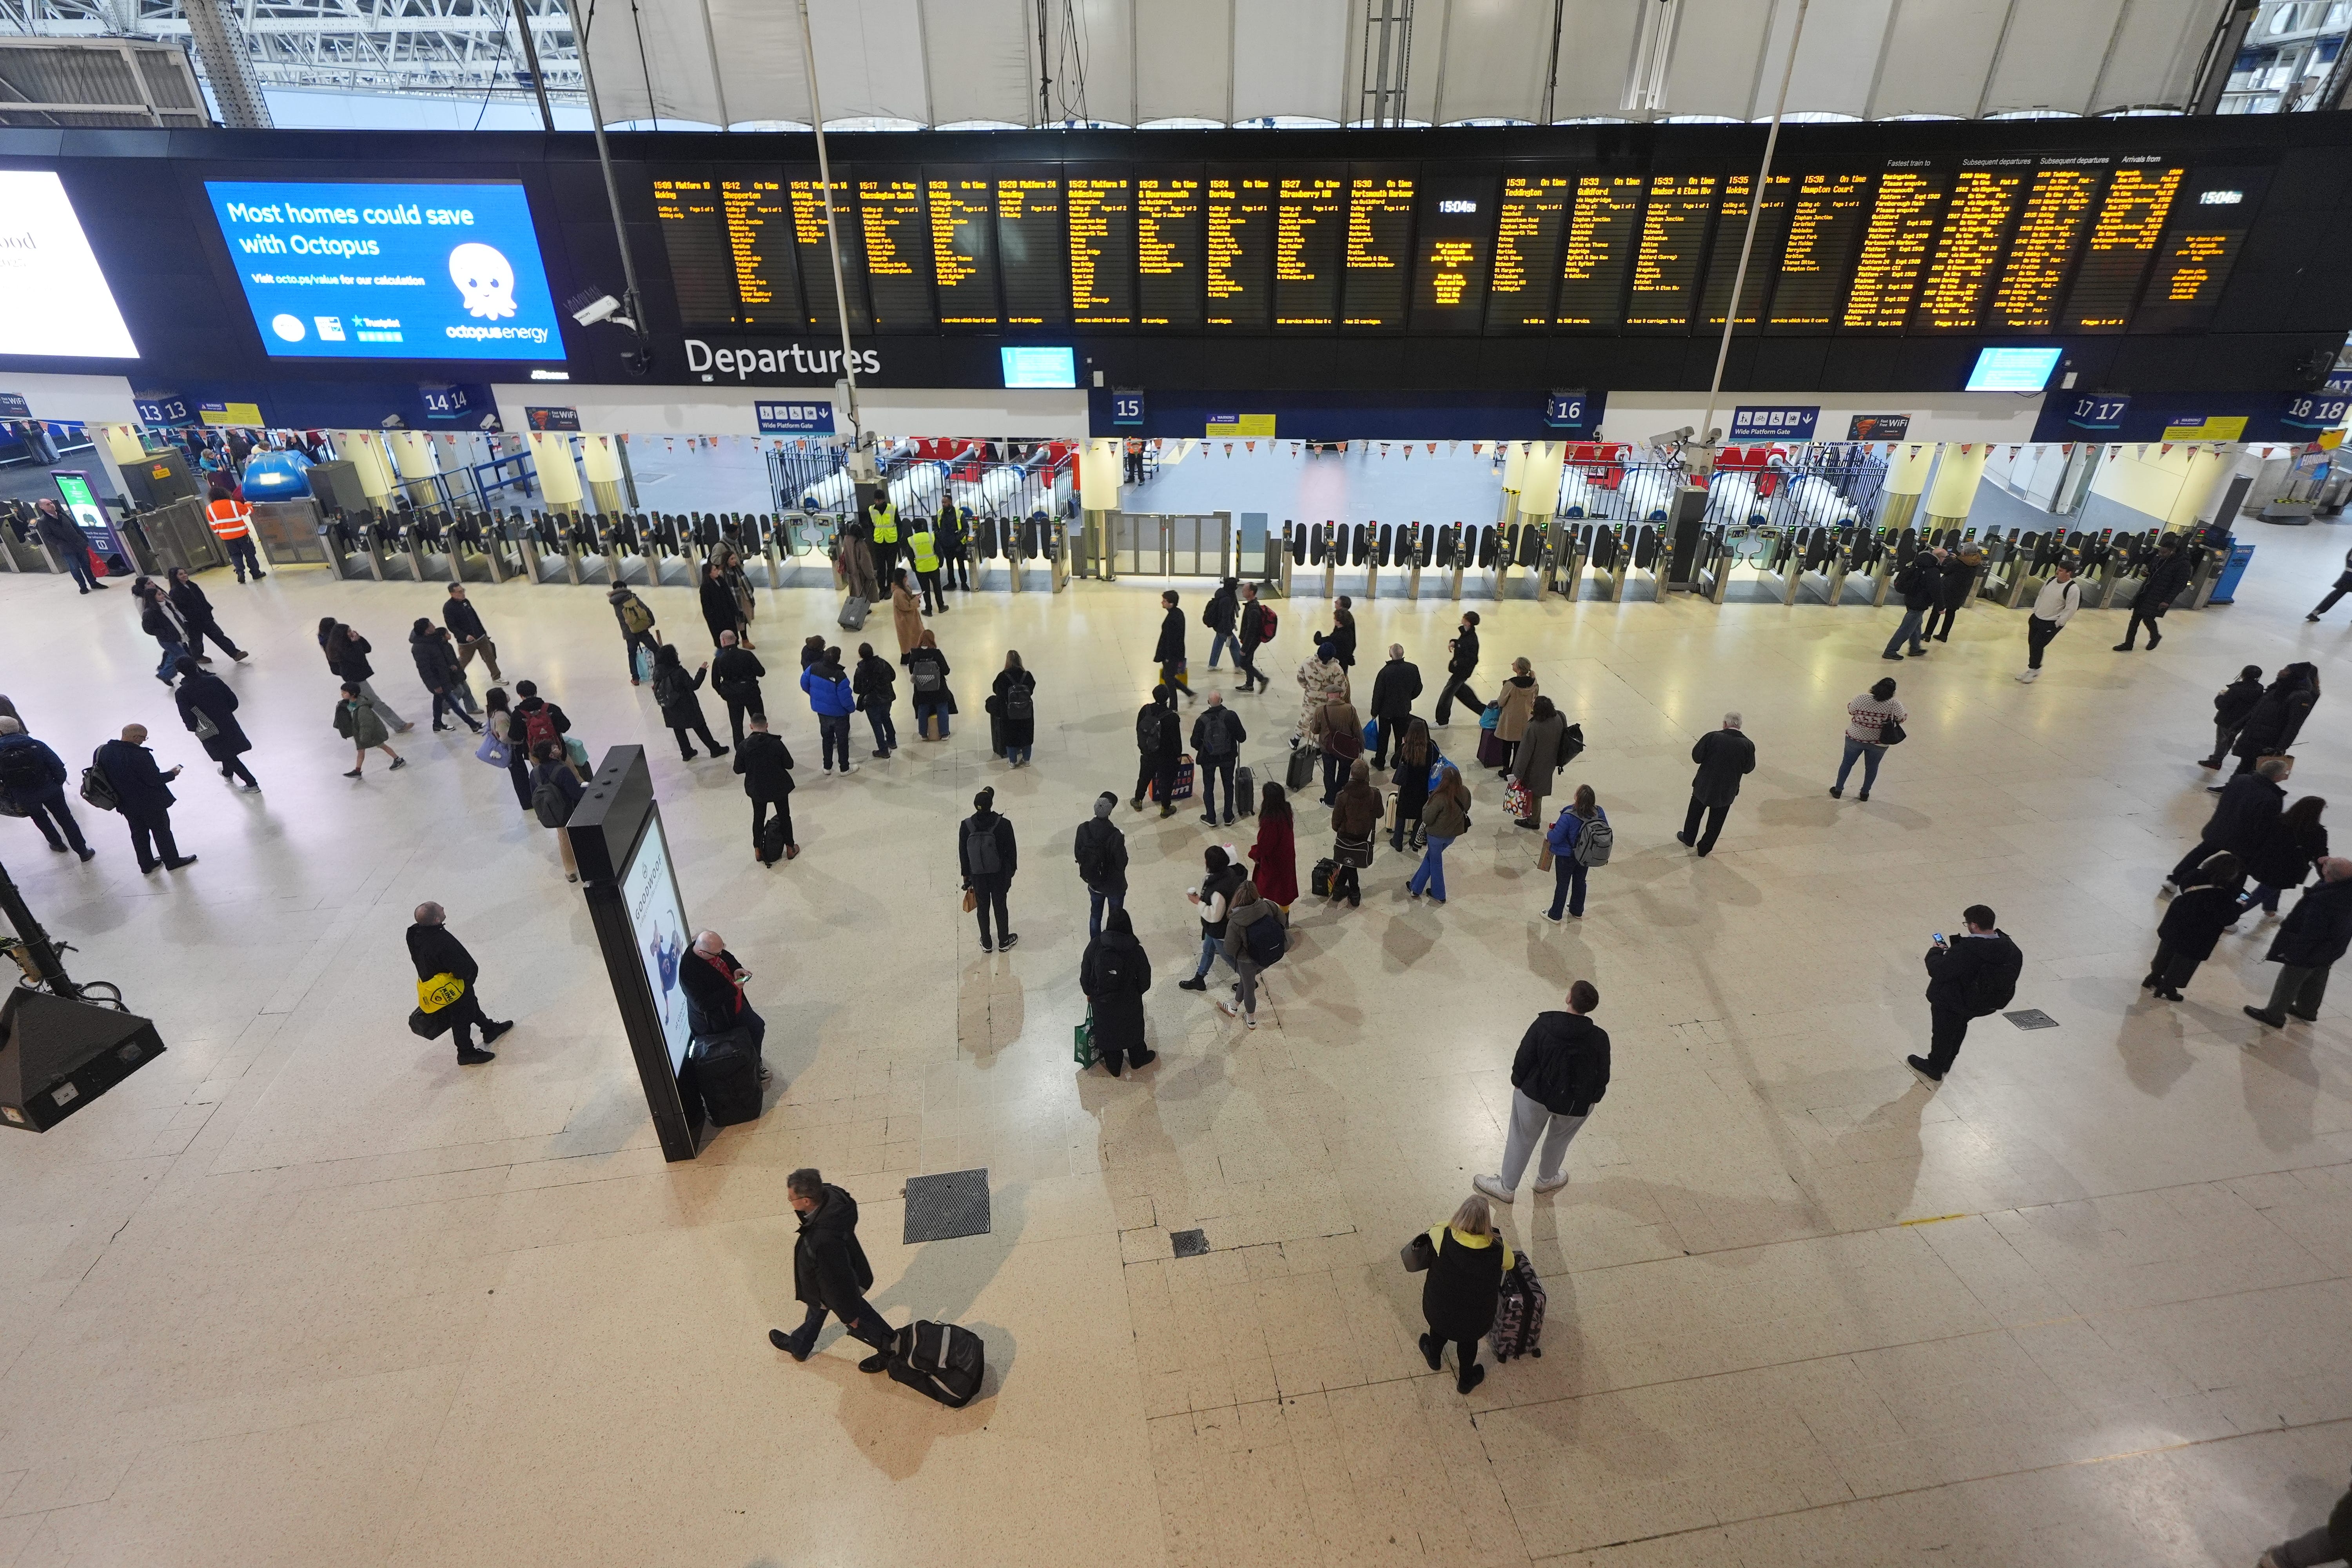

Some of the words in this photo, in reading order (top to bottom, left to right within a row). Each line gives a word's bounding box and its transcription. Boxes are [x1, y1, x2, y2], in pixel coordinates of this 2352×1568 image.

[791, 191, 813, 200] Woking
[860, 192, 895, 200] Chessington
[929, 191, 951, 199] Woking
[998, 191, 1024, 199] Reading
[227, 203, 283, 223] Most
[287, 203, 359, 225] homes
[365, 204, 422, 225] could
[426, 209, 474, 225] save
[238, 234, 287, 254] with
[290, 235, 380, 259] Octopus
[251, 274, 274, 284] Visit
[340, 275, 355, 285] for
[356, 277, 372, 285] our
[374, 275, 425, 286] calculation
[684, 339, 881, 380] Departures
[425, 394, 448, 411] 14
[451, 391, 466, 409] 14
[1117, 400, 1139, 417] 15
[1546, 398, 1555, 416] 16
[2074, 399, 2094, 417] 17
[2289, 398, 2312, 417] 18
[139, 405, 162, 422] 13
[165, 401, 187, 419] 13
[1557, 402, 1580, 419] 16
[2095, 403, 2124, 420] 17
[2315, 402, 2345, 419] 18
[636, 853, 661, 920] GOODWOOF
